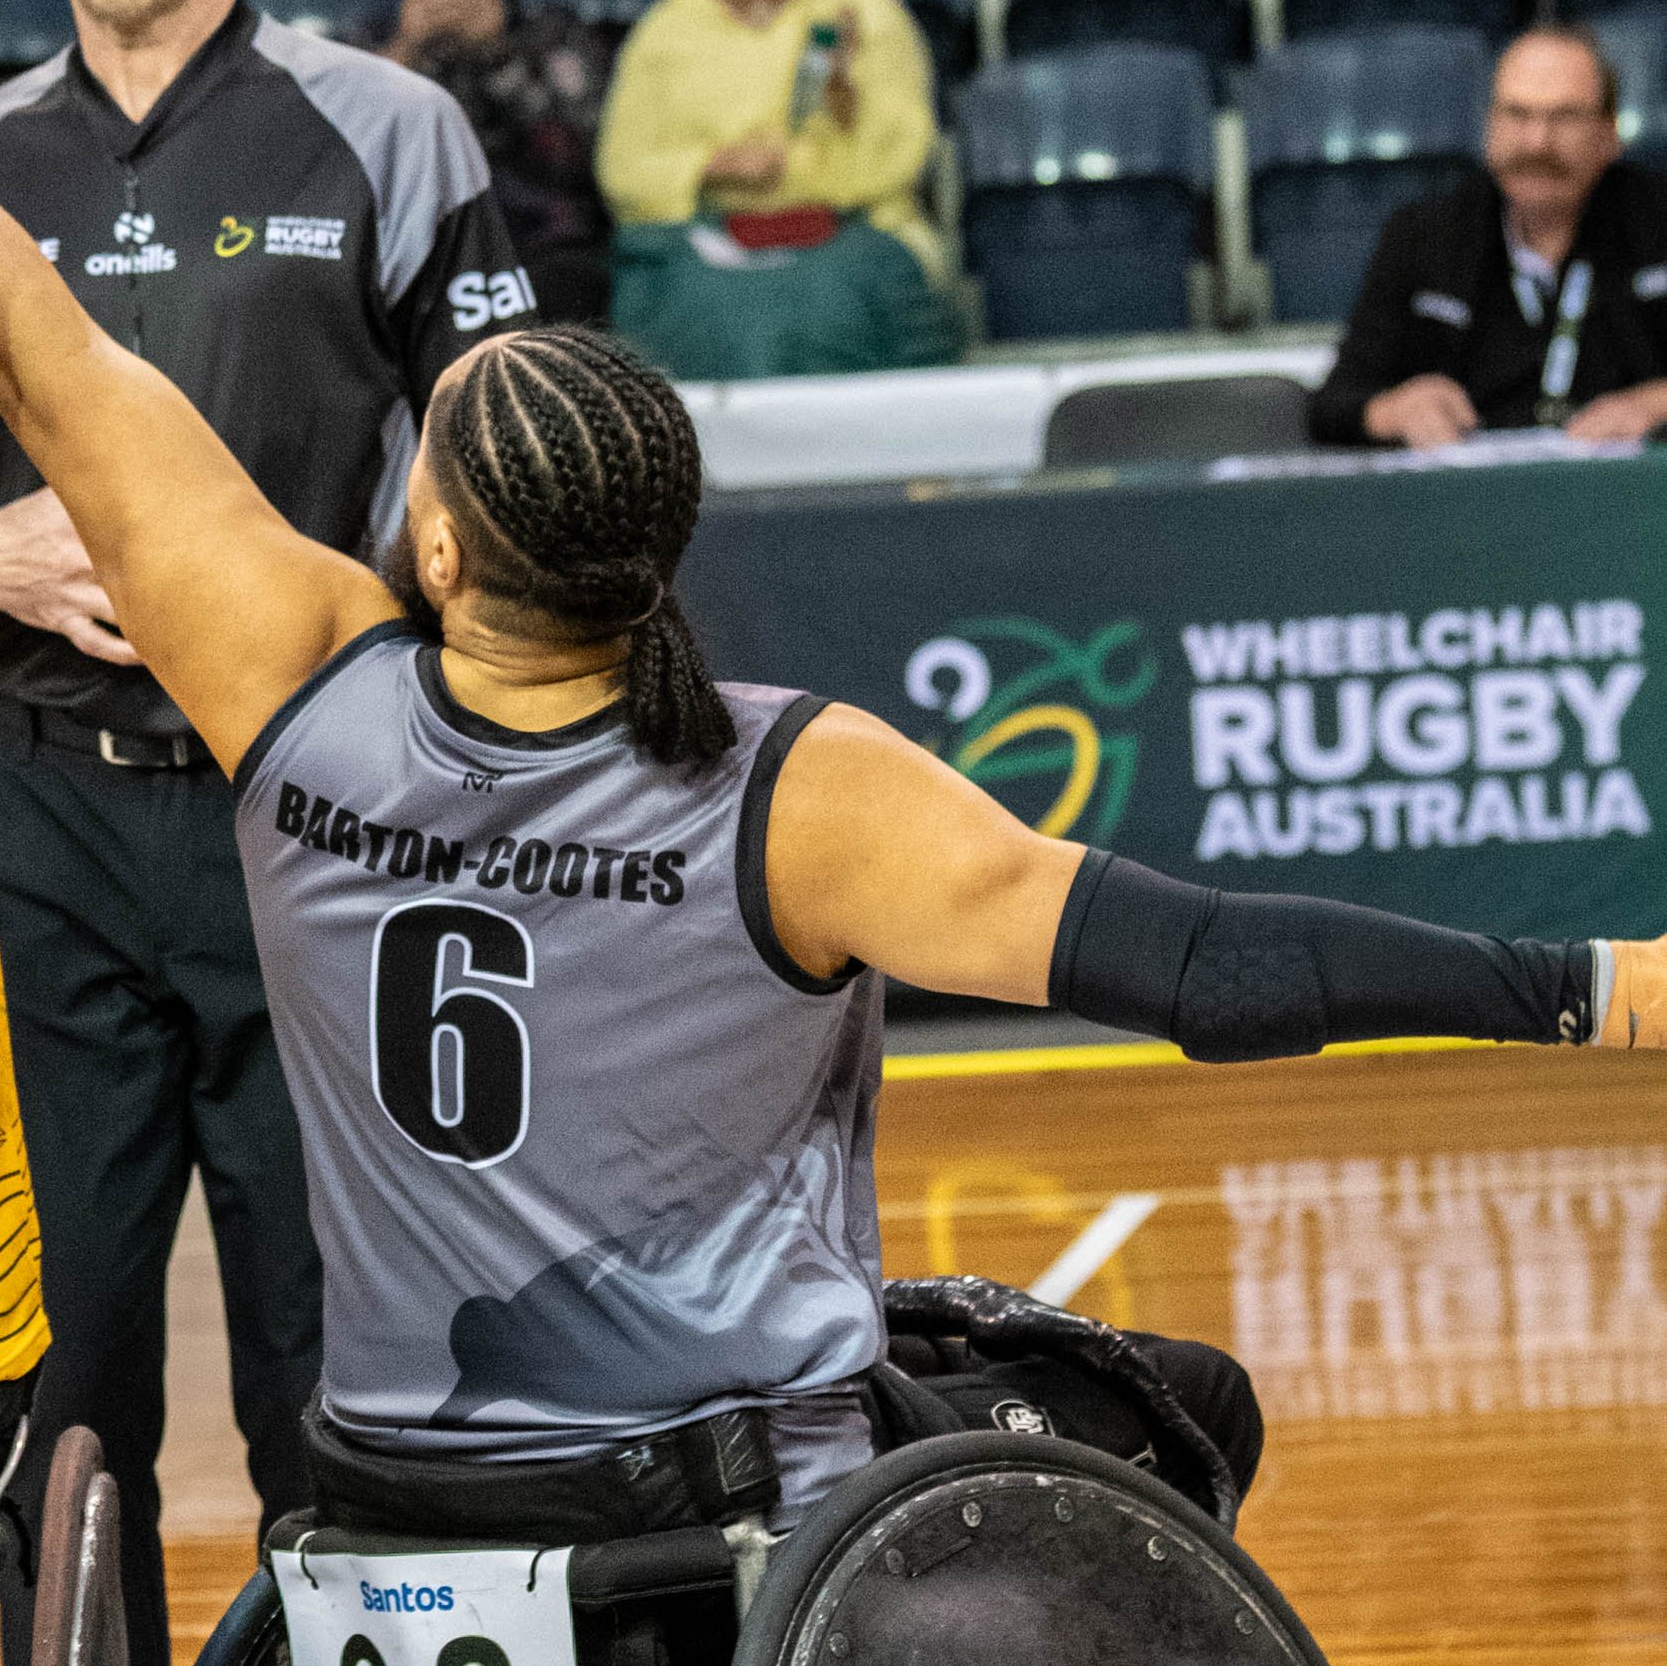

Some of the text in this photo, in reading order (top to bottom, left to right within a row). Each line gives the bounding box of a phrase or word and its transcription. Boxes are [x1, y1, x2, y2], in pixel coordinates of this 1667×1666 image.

[265, 227, 345, 249] RUGBY
[1182, 598, 1644, 684] WHEELCHAIR
[1191, 662, 1646, 790] RUGBY
[275, 780, 687, 907] BARTON-COOTES
[1196, 767, 1650, 862] AUSTRALIA
[369, 897, 535, 1170] 6
[361, 1580, 455, 1613] Santos
